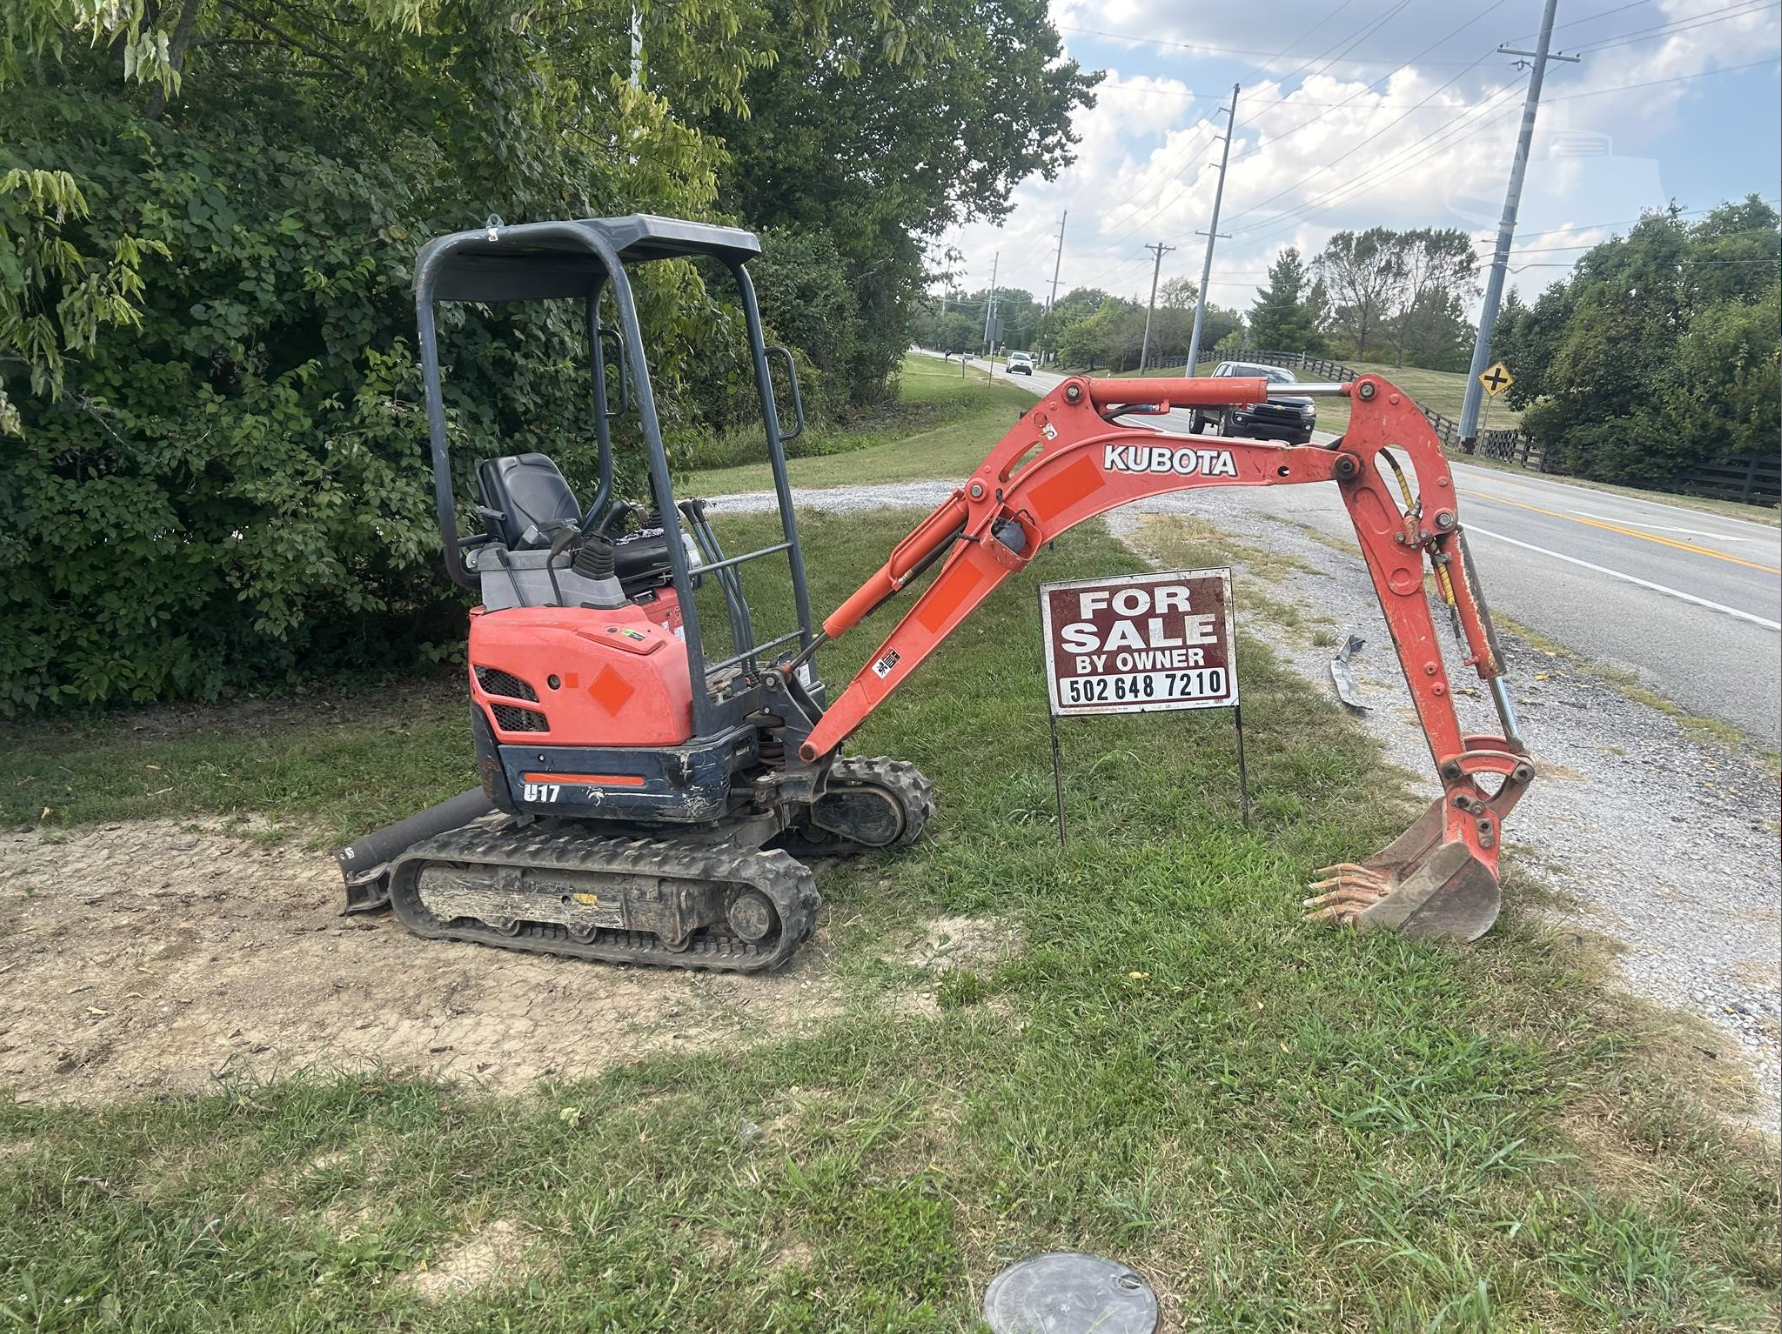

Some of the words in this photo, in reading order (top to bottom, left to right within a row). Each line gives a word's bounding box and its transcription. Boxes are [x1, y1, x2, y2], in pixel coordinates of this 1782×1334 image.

[1103, 444, 1238, 477] KUBOTA
[1079, 585, 1192, 619] FOR
[1061, 613, 1218, 653] SALE
[1075, 654, 1107, 674] BY
[1116, 648, 1205, 671] OWNER
[1069, 678, 1108, 702] 502
[1114, 675, 1154, 700] 648
[1165, 670, 1221, 697] 7210
[523, 784, 560, 803] U17
